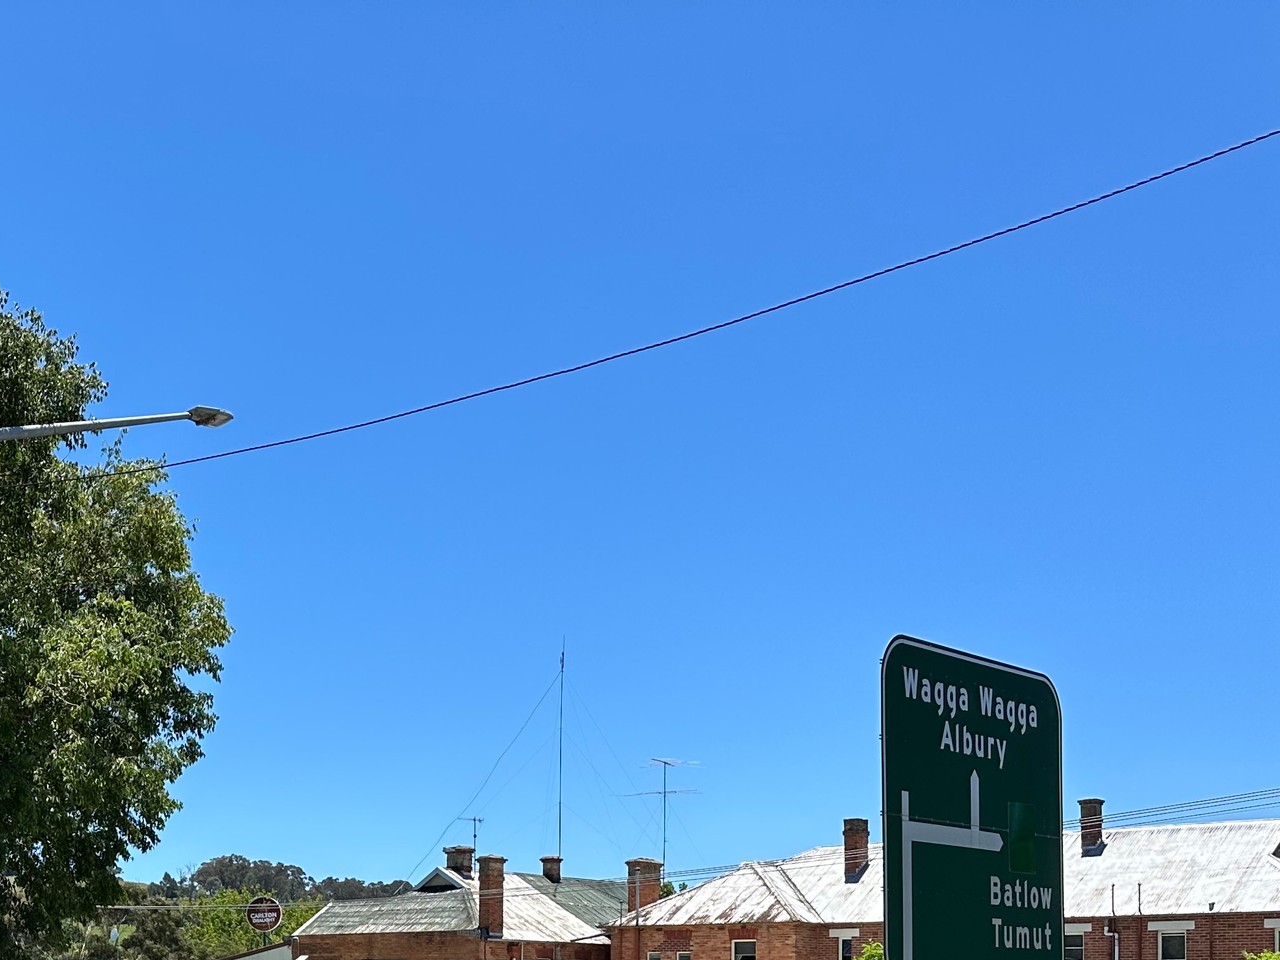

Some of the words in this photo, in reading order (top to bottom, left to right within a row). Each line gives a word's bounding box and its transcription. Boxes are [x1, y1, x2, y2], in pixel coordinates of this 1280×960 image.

[902, 666, 968, 719] Wagga
[979, 685, 1037, 735] Wagga
[940, 720, 1006, 769] Albury
[990, 875, 1052, 909] Batlow
[991, 917, 1052, 950] Tumut
